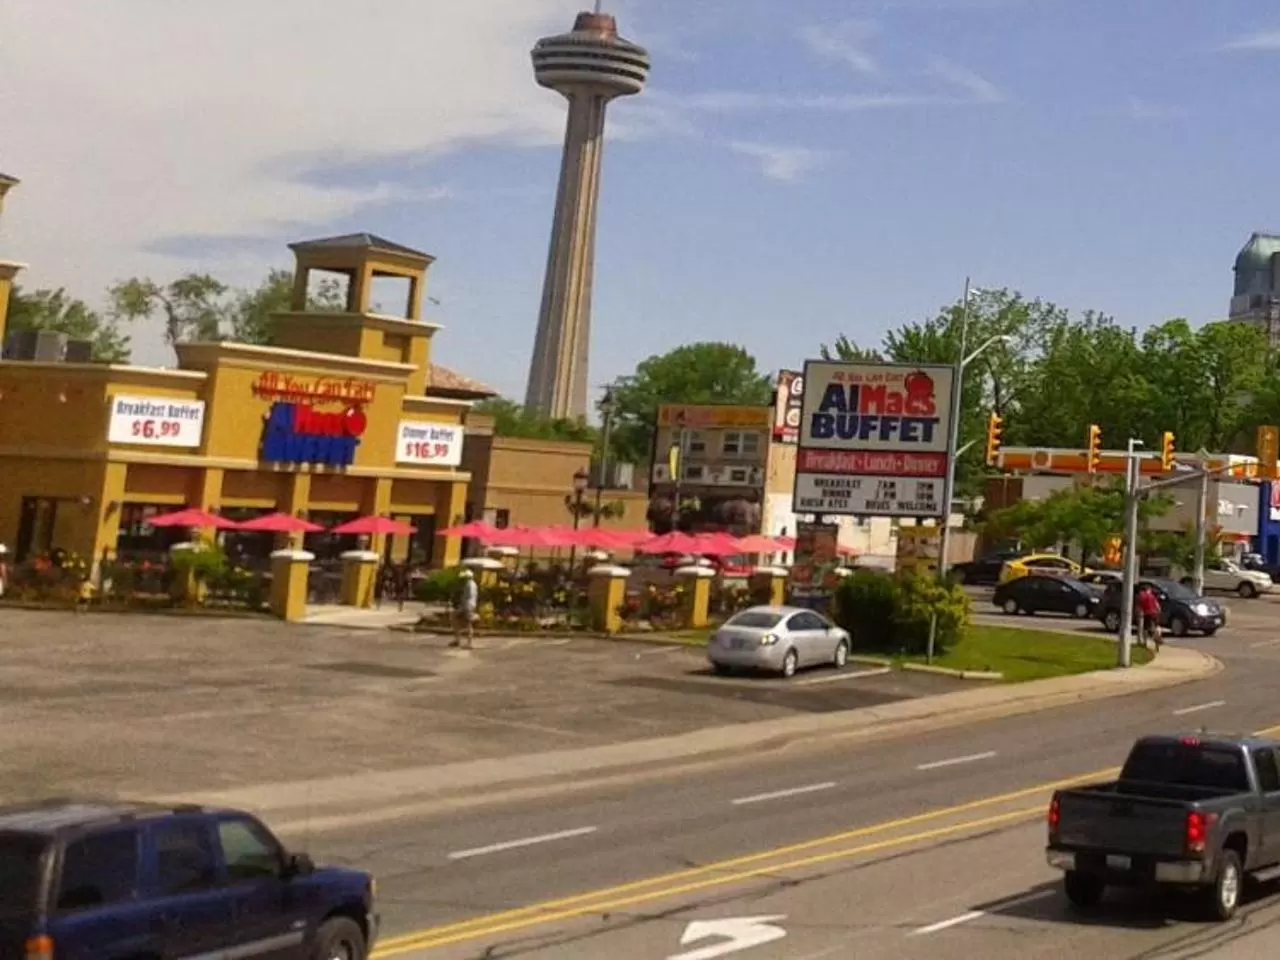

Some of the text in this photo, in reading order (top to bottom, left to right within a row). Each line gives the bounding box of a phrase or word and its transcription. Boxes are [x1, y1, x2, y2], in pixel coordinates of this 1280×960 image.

[116, 400, 201, 421] Breakfast Buffet
[131, 419, 181, 440] $6.99
[811, 413, 940, 442] BUFFET
[405, 441, 449, 459] $16.99
[805, 450, 940, 472] Breakfast Lunch Dinner
